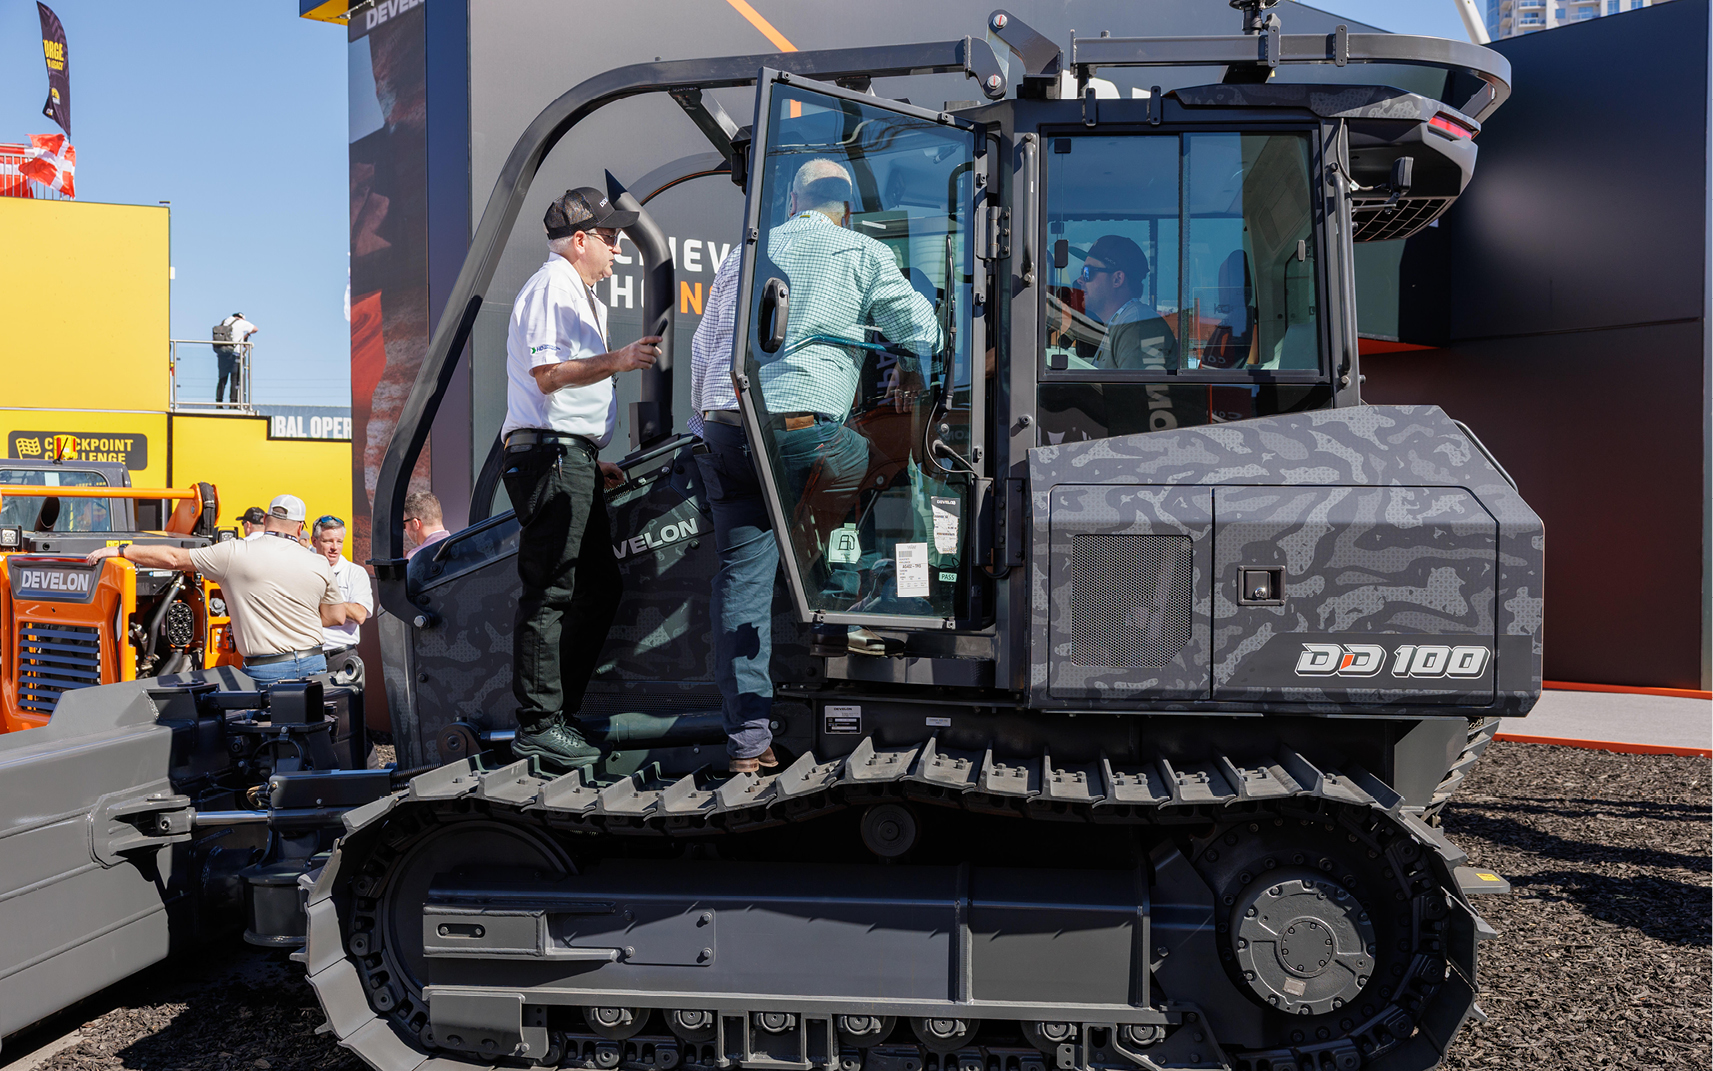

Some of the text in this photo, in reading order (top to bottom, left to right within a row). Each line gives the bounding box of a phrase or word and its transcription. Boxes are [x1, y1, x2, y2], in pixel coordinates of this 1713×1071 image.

[43, 39, 64, 61] ORGE
[44, 437, 133, 452] CCKPOINT
[612, 517, 699, 559] VELON
[21, 570, 89, 592] DEVELON
[941, 573, 955, 581] PASS
[1391, 645, 1491, 679] 100
